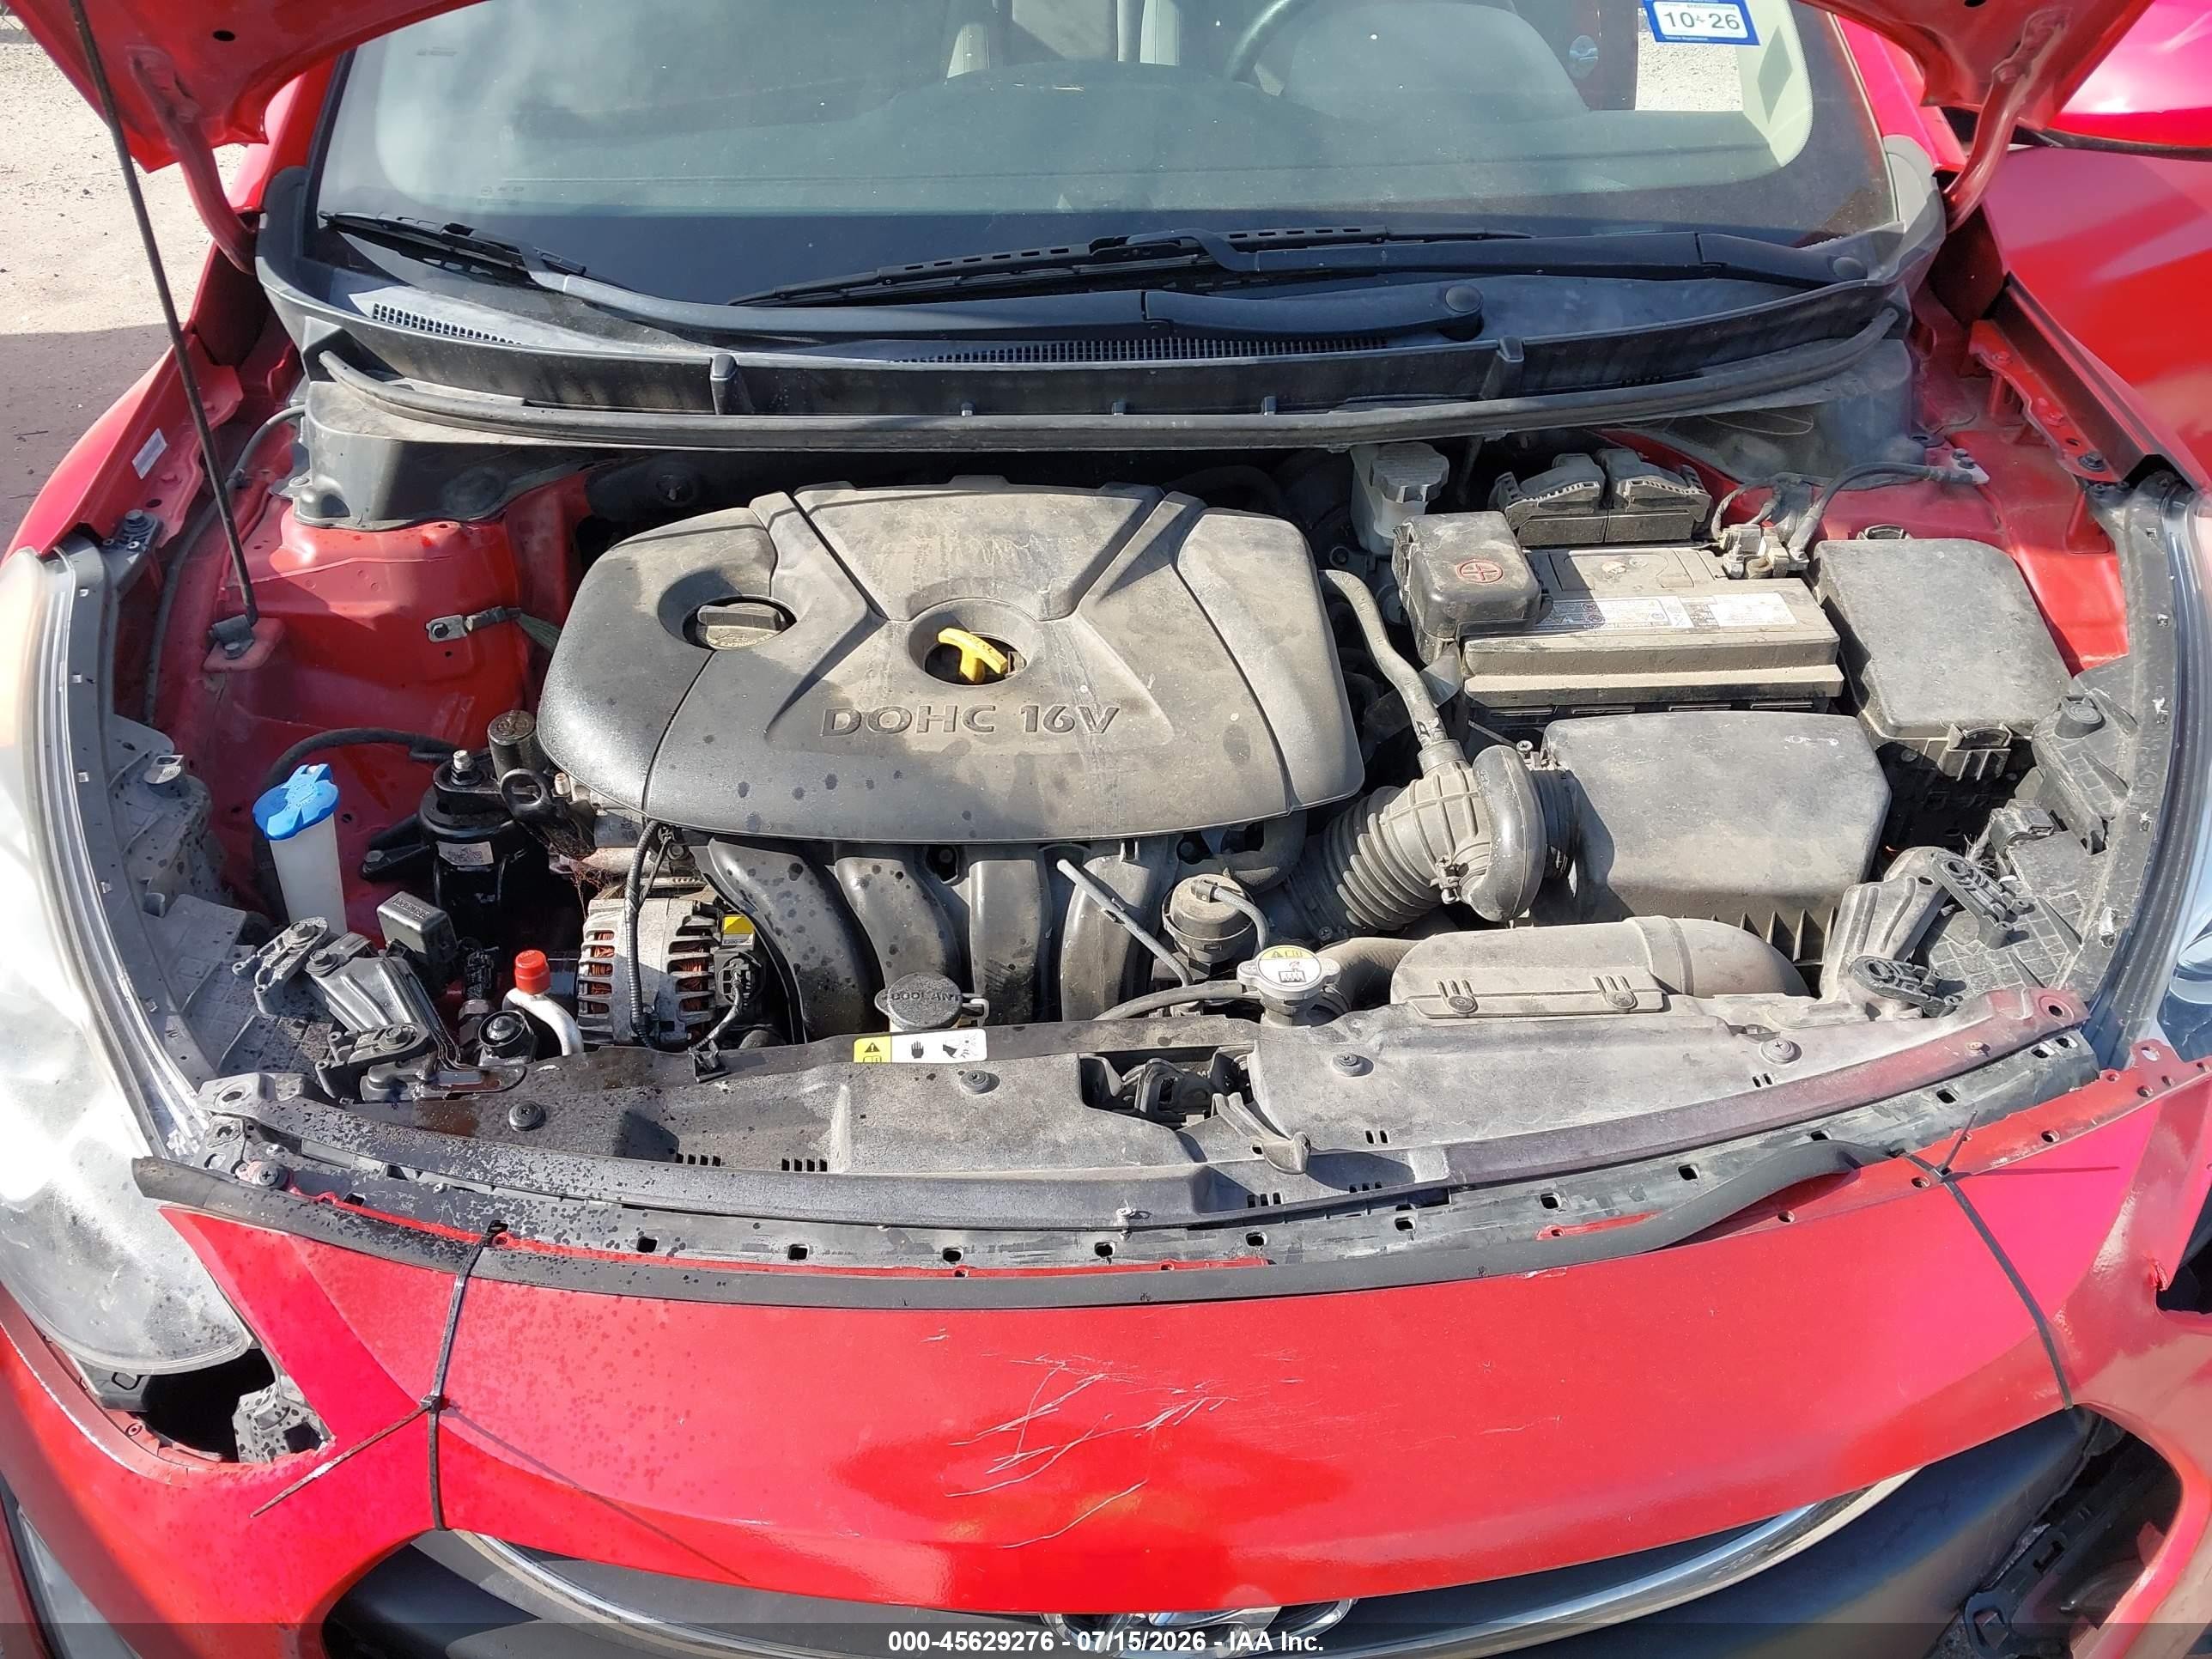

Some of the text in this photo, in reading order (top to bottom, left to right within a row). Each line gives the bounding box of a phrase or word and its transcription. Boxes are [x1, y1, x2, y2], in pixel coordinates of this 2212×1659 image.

[1663, 11, 1741, 30] 10 26
[821, 704, 1121, 737] DOHC 16V
[890, 990, 962, 1002] COOLANT
